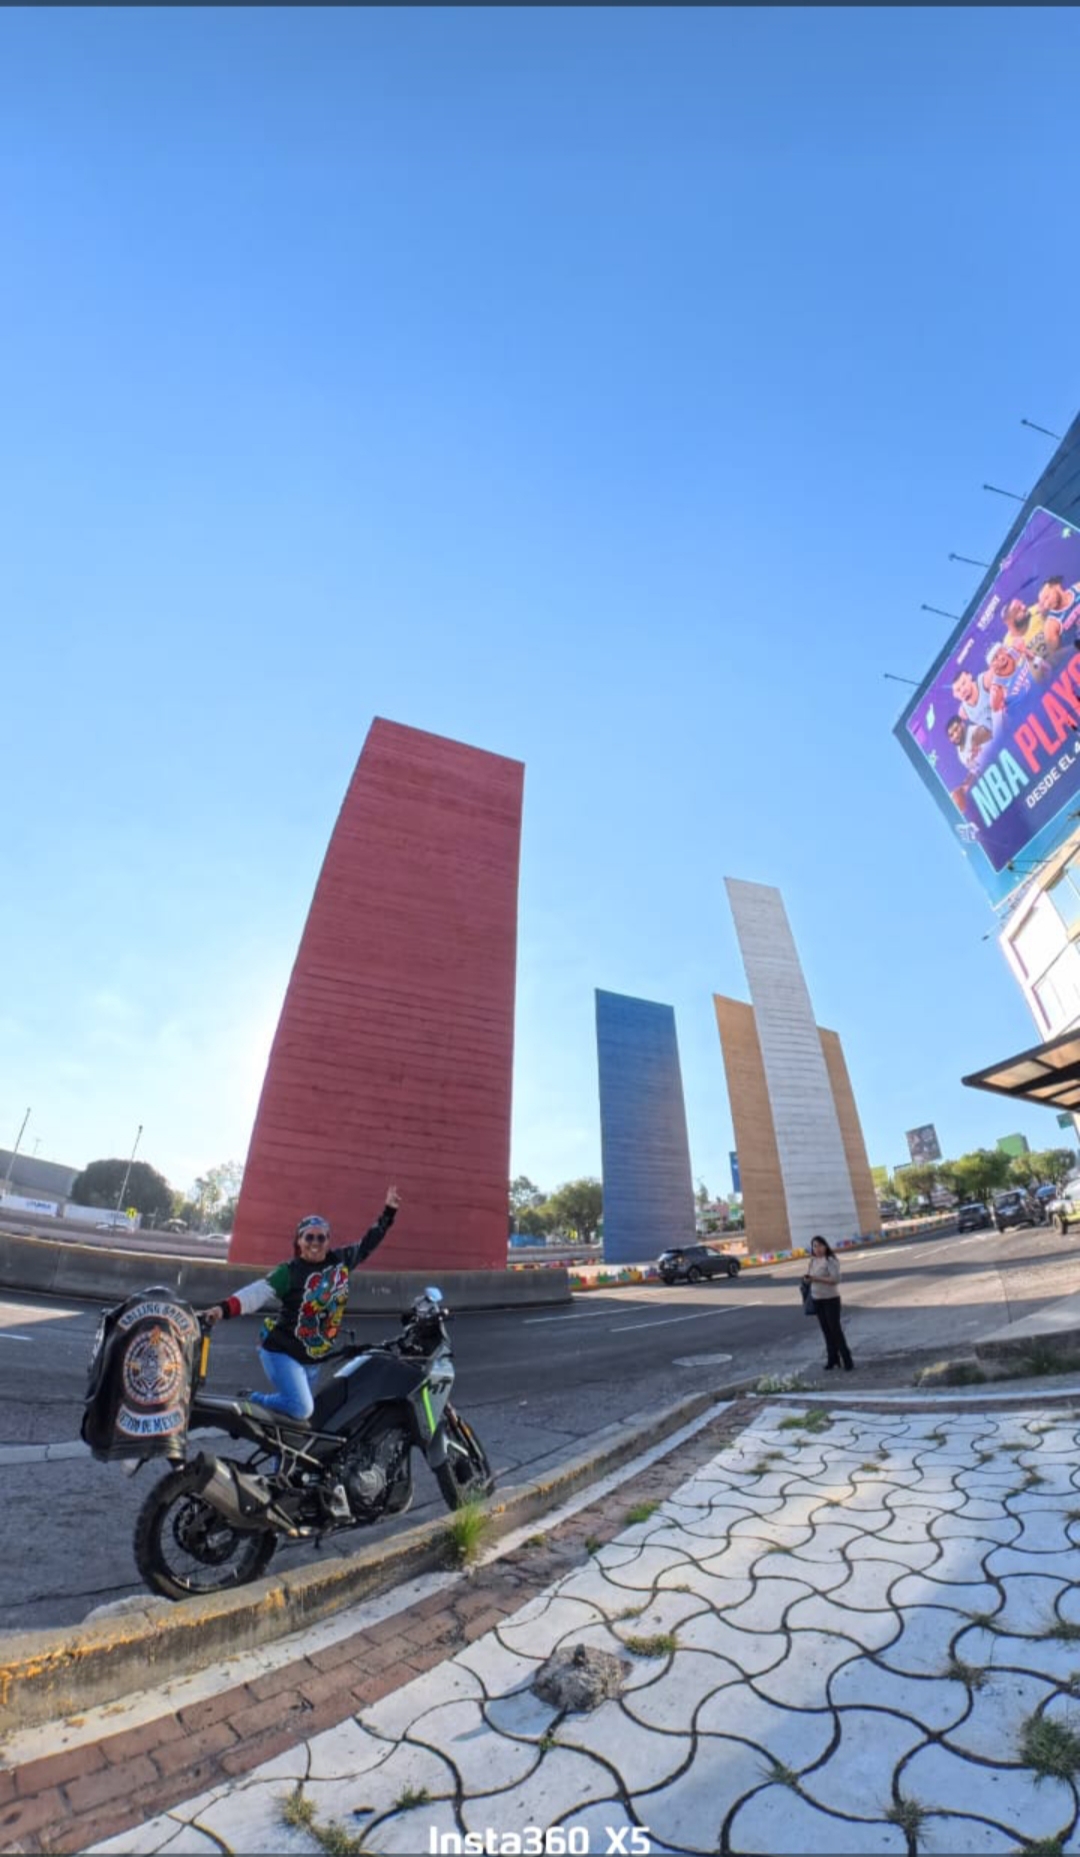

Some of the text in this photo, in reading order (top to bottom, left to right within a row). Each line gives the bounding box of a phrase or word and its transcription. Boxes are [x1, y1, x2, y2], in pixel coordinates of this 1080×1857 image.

[970, 747, 1030, 828] NBA
[1025, 767, 1062, 809] DESDE
[1058, 754, 1076, 772] EL
[420, 1376, 452, 1395] MT
